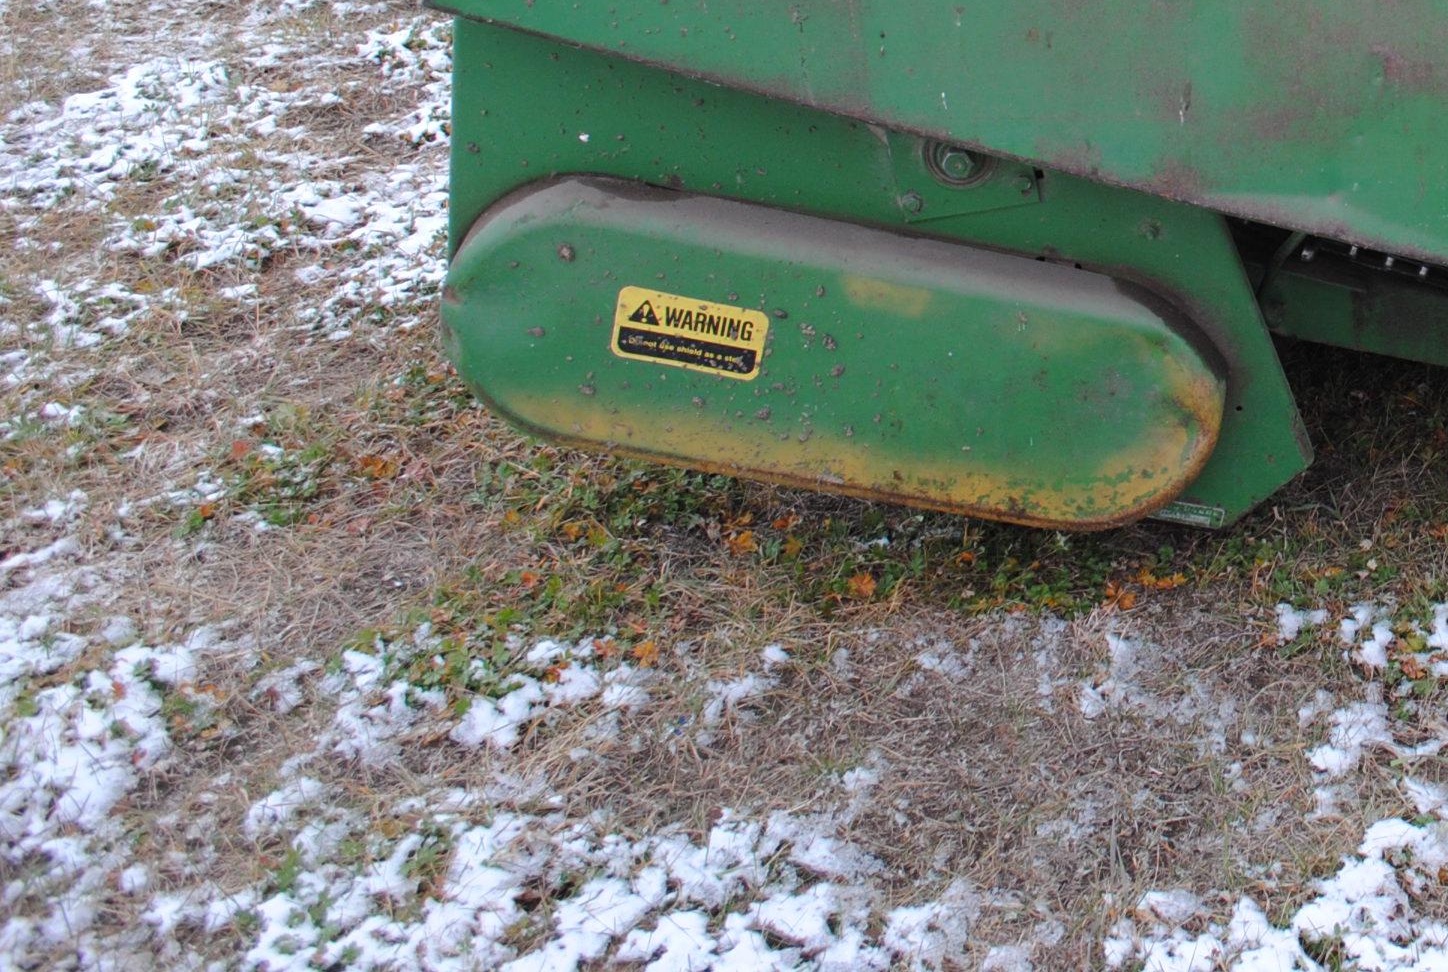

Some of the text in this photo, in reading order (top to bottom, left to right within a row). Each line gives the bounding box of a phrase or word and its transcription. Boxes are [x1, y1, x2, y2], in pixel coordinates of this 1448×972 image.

[665, 306, 754, 341] WARNING
[659, 342, 675, 351] use
[676, 345, 703, 356] shield
